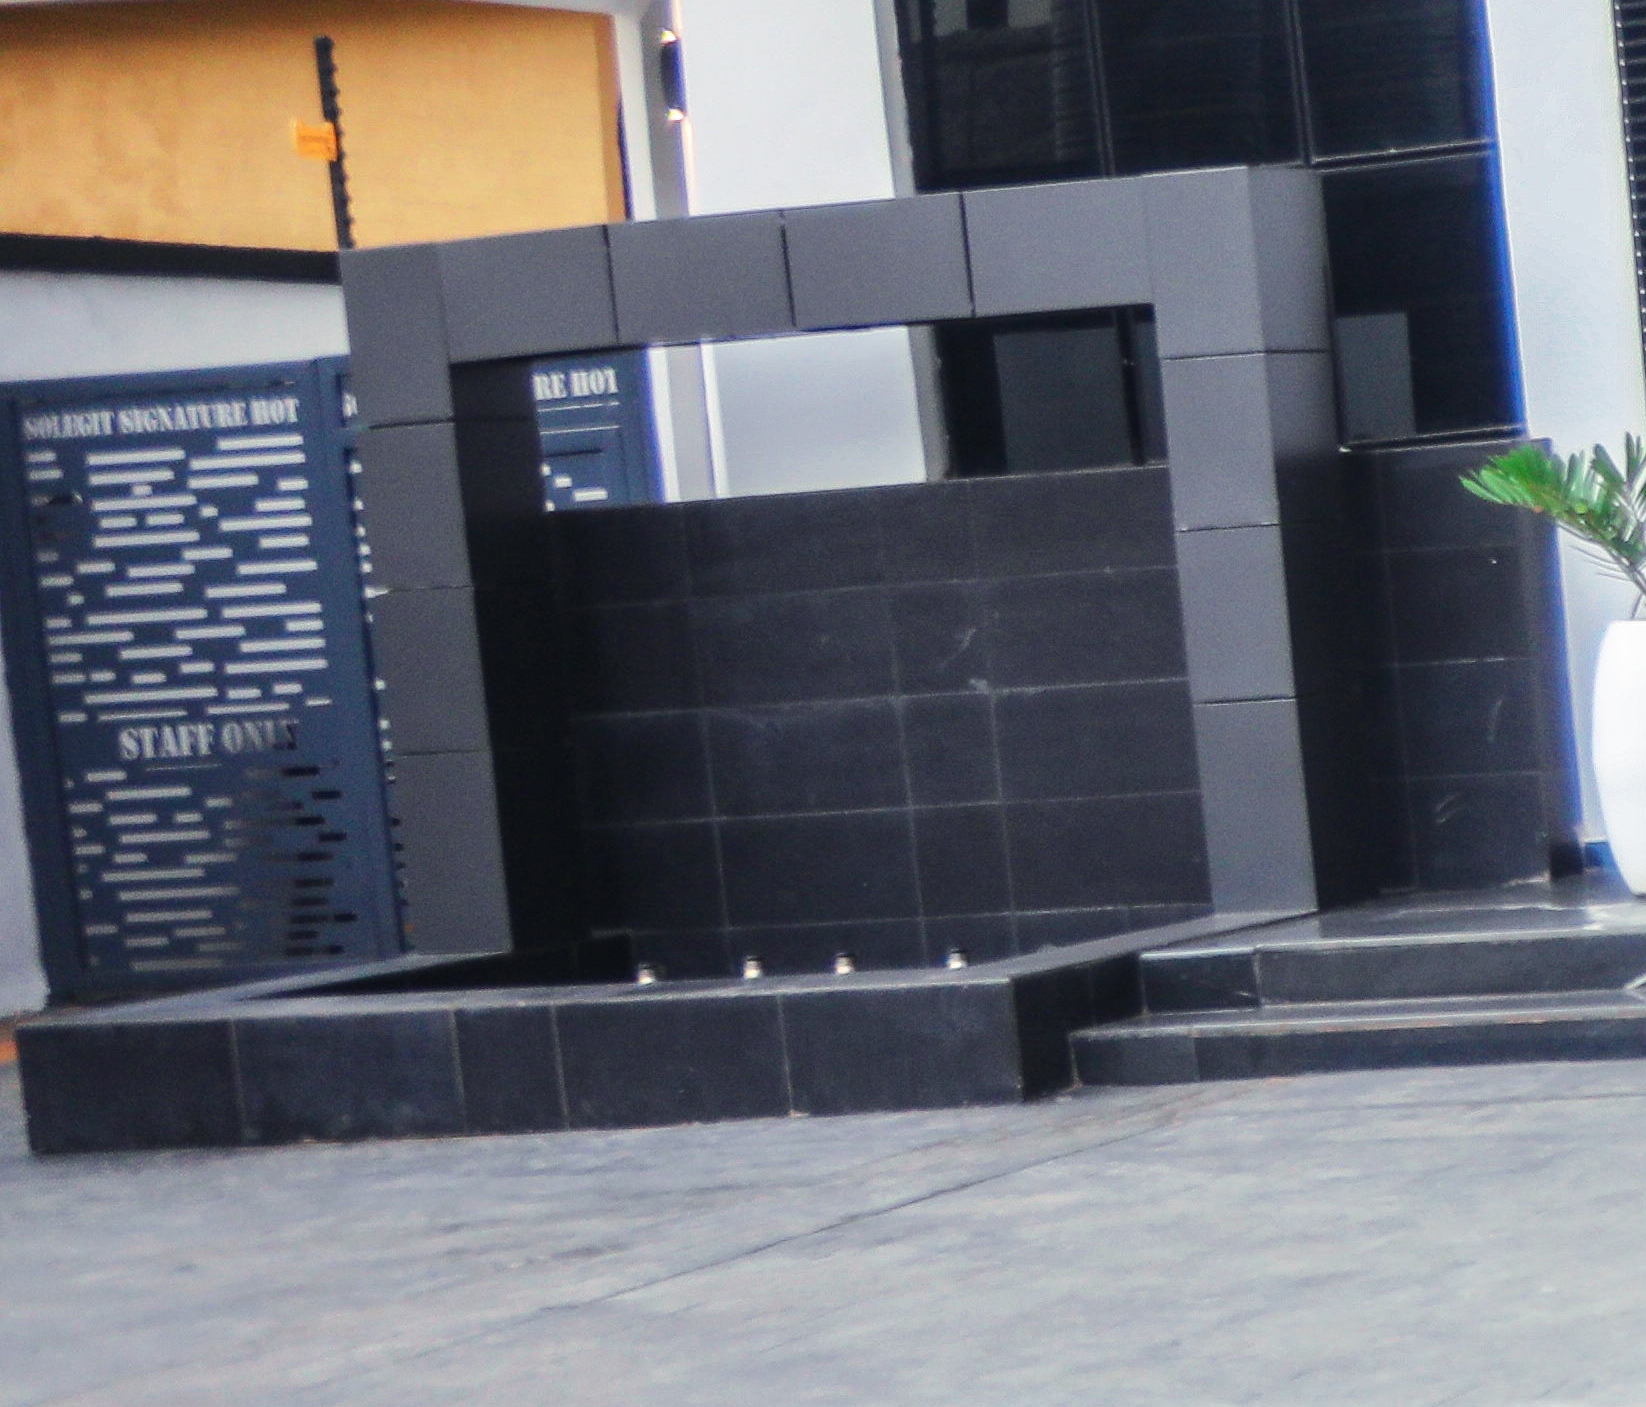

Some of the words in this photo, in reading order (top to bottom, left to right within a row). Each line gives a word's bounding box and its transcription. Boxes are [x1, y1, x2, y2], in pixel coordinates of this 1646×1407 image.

[117, 401, 248, 435] SIGNATURE
[250, 397, 300, 426] HOT
[118, 721, 216, 761] STAFF
[220, 718, 301, 754] ONLY
